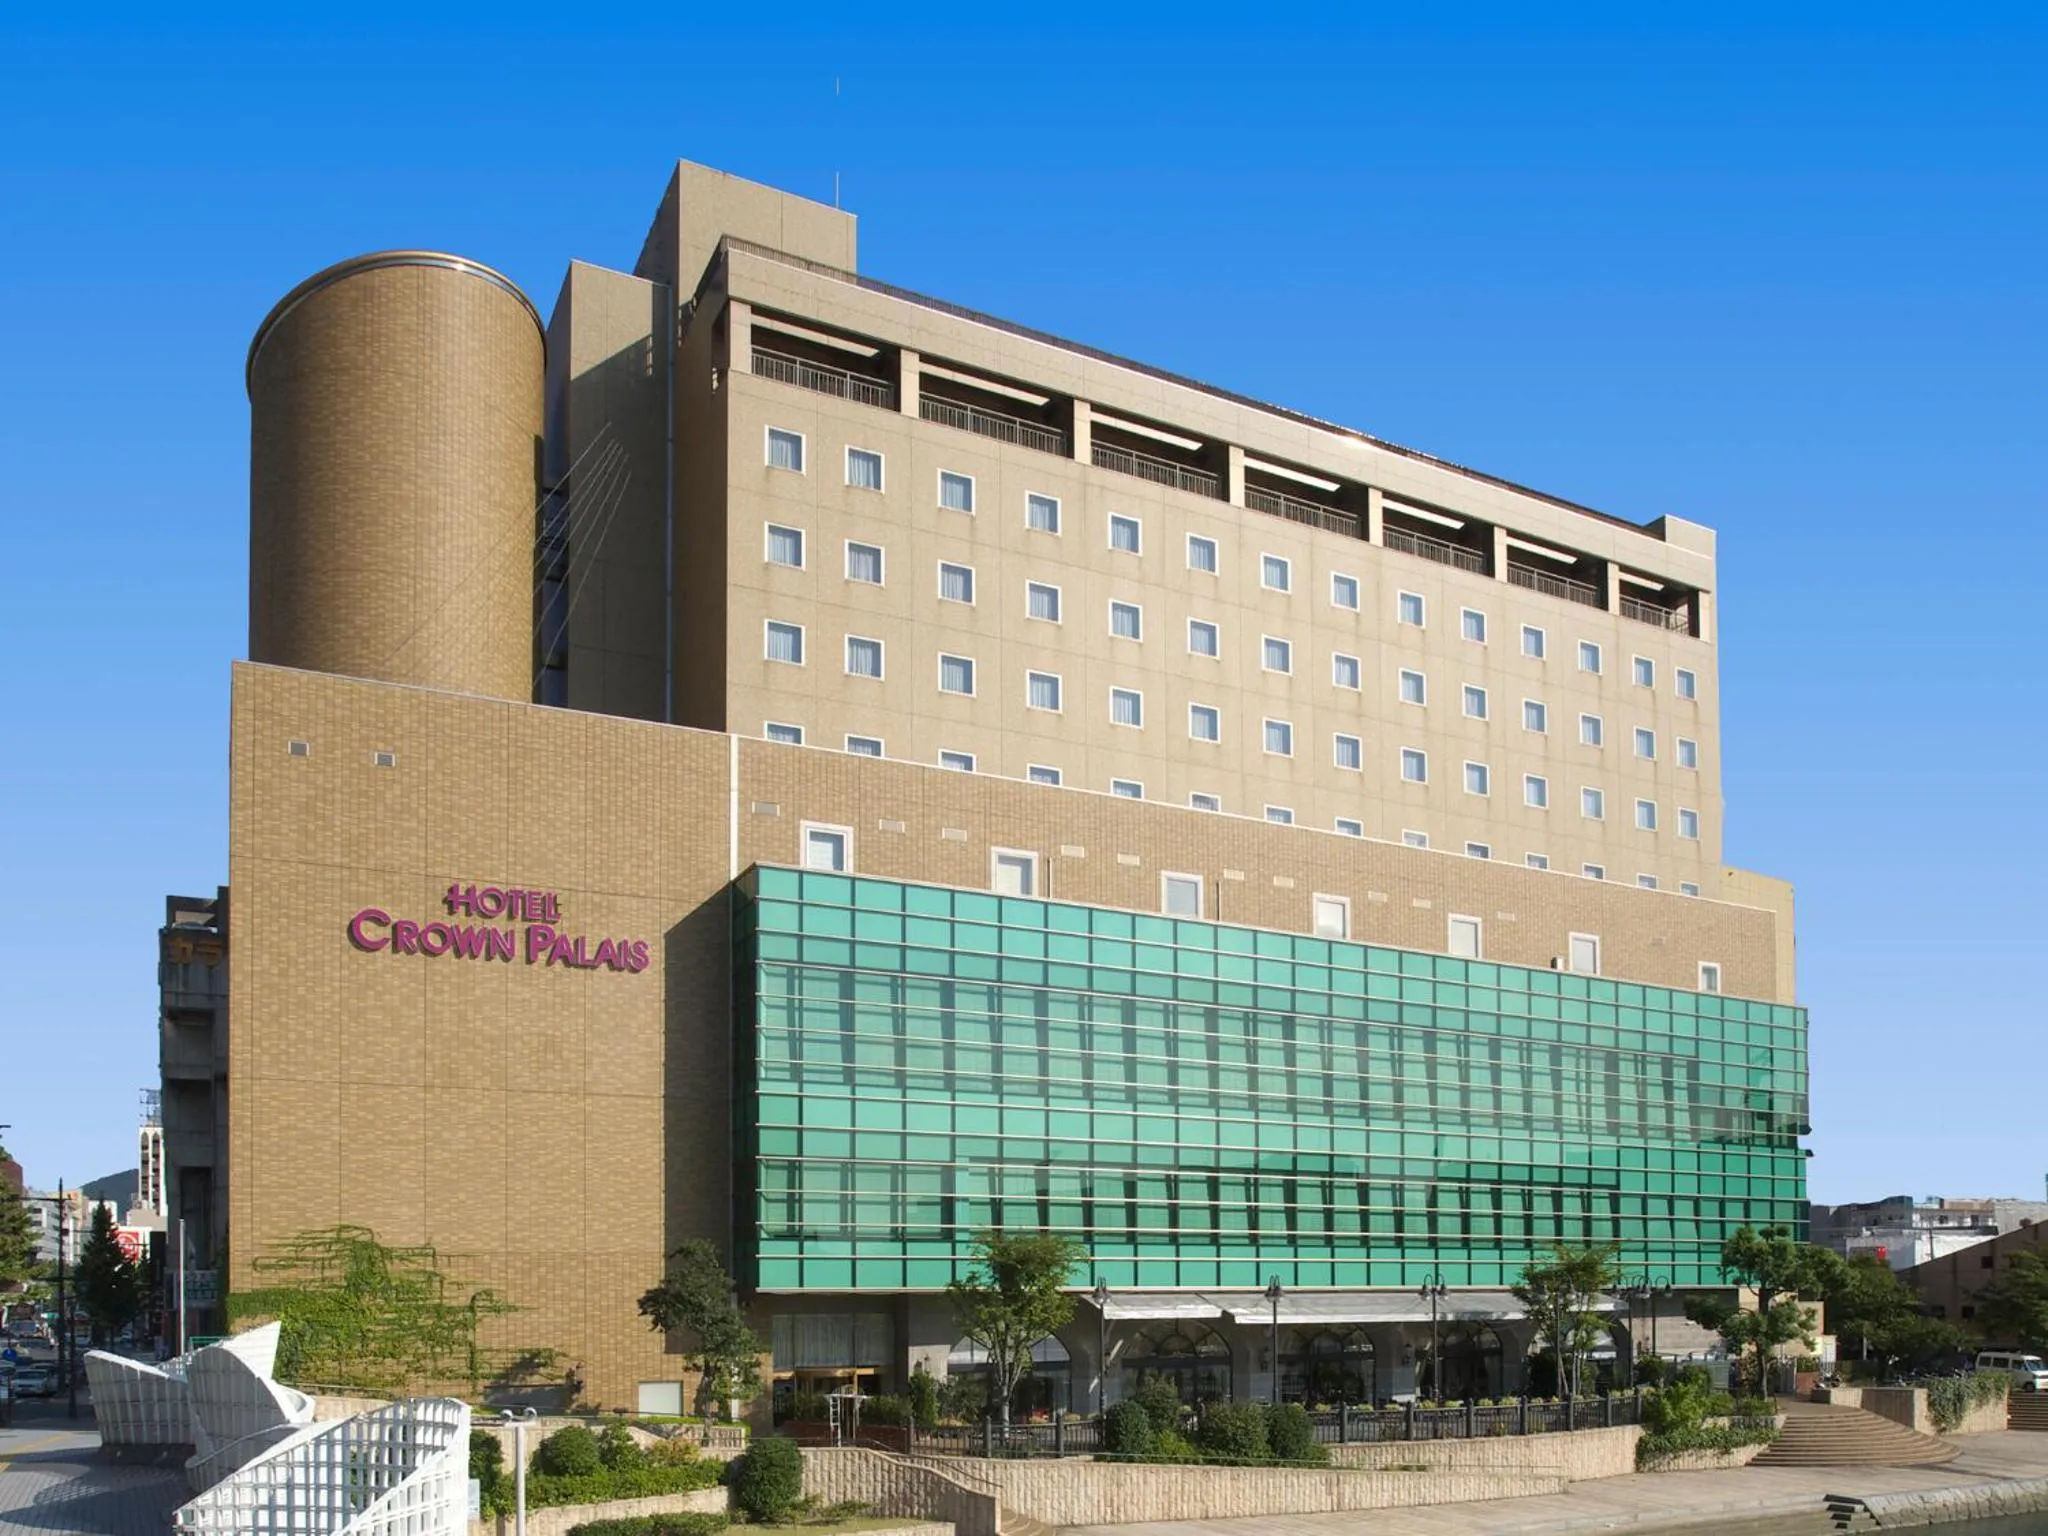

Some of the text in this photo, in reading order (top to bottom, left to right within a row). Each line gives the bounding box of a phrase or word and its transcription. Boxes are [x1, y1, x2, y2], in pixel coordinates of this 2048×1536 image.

[447, 884, 561, 920] HOTEL
[350, 908, 649, 972] CROWN PALAIS
